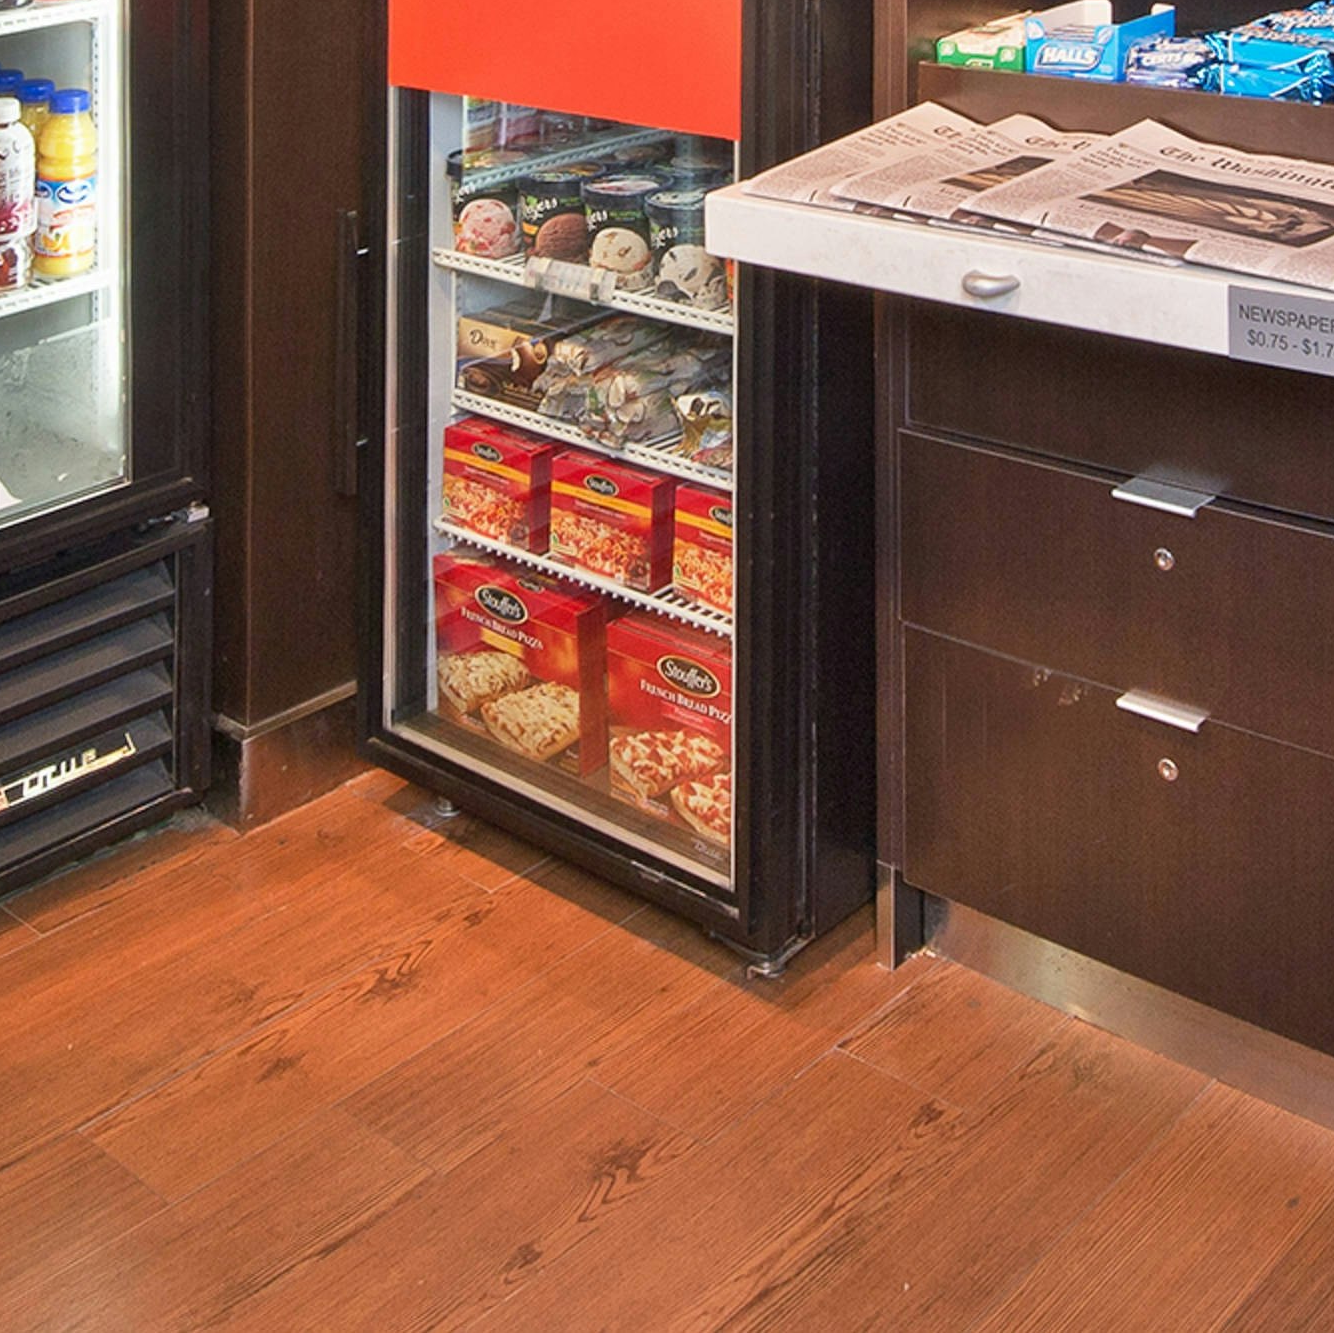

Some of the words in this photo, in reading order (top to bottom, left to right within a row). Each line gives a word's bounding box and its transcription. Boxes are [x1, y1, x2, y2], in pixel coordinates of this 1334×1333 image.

[1043, 47, 1098, 63] HALLS
[1159, 145, 1206, 164] The
[1247, 329, 1289, 351] $0.75
[482, 589, 522, 618] Stouffer's
[461, 606, 492, 629] FRENCH
[492, 620, 517, 640] BREAD
[518, 630, 544, 650] PIZZA
[665, 659, 713, 694] Stouffer's
[640, 679, 676, 705] FRENCH
[677, 694, 708, 715] BREAD
[708, 704, 732, 725] PIZZ
